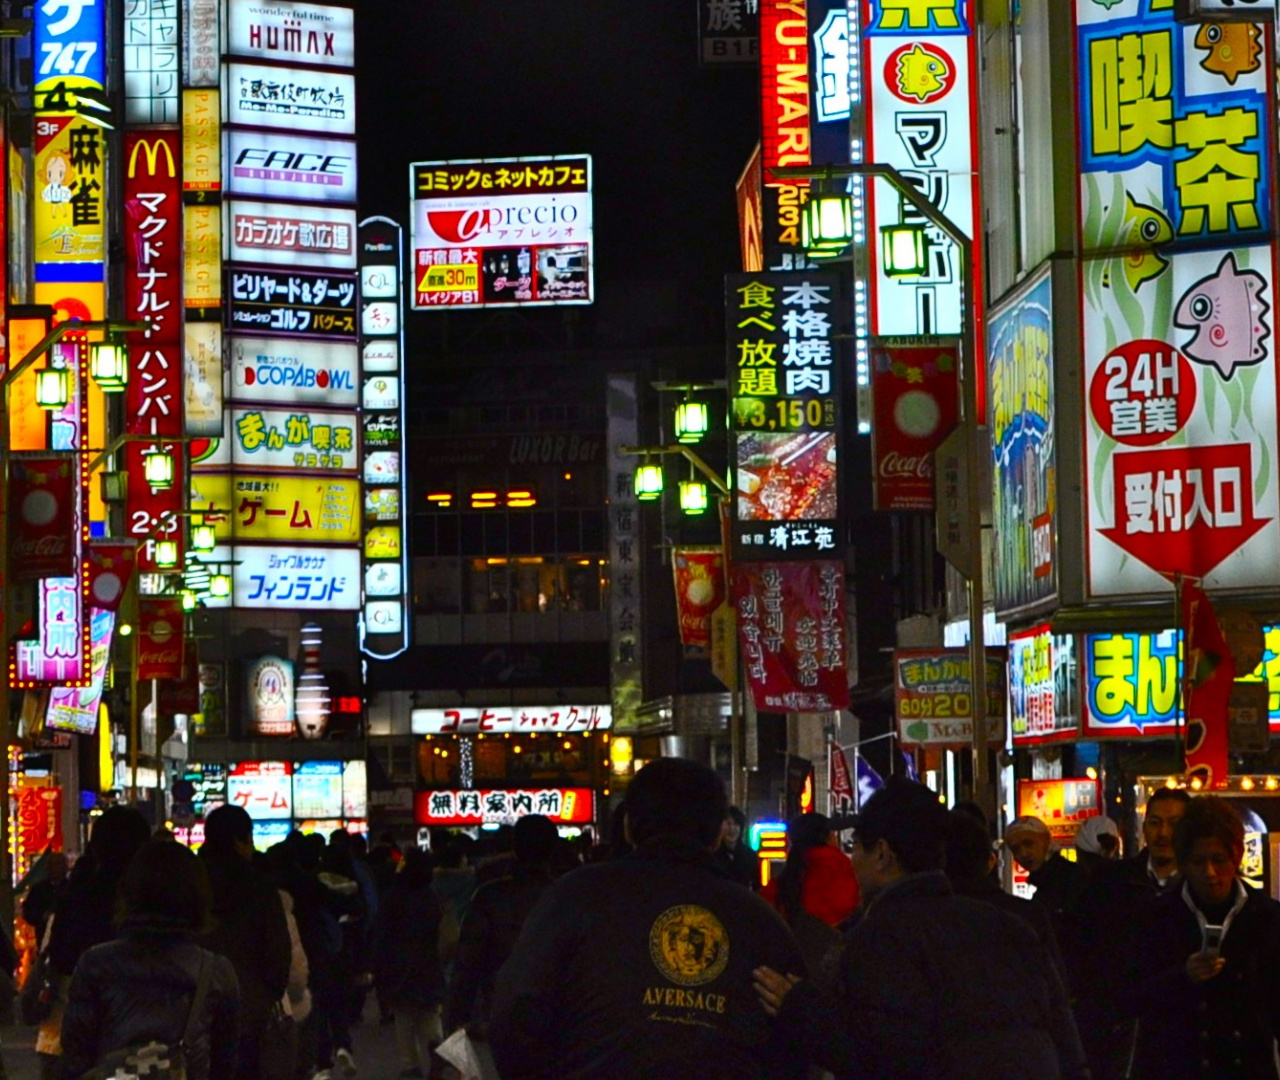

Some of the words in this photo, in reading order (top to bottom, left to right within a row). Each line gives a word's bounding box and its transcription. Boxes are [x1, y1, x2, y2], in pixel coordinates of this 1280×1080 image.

[40, 42, 98, 75] 747
[37, 122, 60, 136] 3F
[69, 124, 101, 227] 麻雀
[234, 147, 352, 174] FACE
[418, 166, 587, 192] コミック&ネットカフェ
[236, 217, 350, 250] カラオケ歌広場
[456, 197, 578, 240] aprecio
[498, 227, 576, 240] アプレシオ
[135, 192, 171, 340] マクドナルド
[418, 248, 479, 266] 新宿最大
[233, 274, 355, 307] ビリヤード&ダーツ
[270, 308, 311, 331] ゴルフ
[736, 281, 778, 396] 食べ放題
[782, 281, 833, 395] 本格焼肉
[1104, 350, 1181, 402] 24H
[237, 411, 353, 452] まんが喫茶
[1109, 397, 1178, 437] 営業
[237, 497, 314, 530] ゲーム
[1123, 466, 1244, 536] 受付入口
[740, 533, 765, 545] 新宿
[247, 574, 347, 602] フィンランド
[440, 709, 513, 732] コーヒー
[234, 791, 289, 810] ゲーム
[429, 792, 561, 816] 無料案内所
